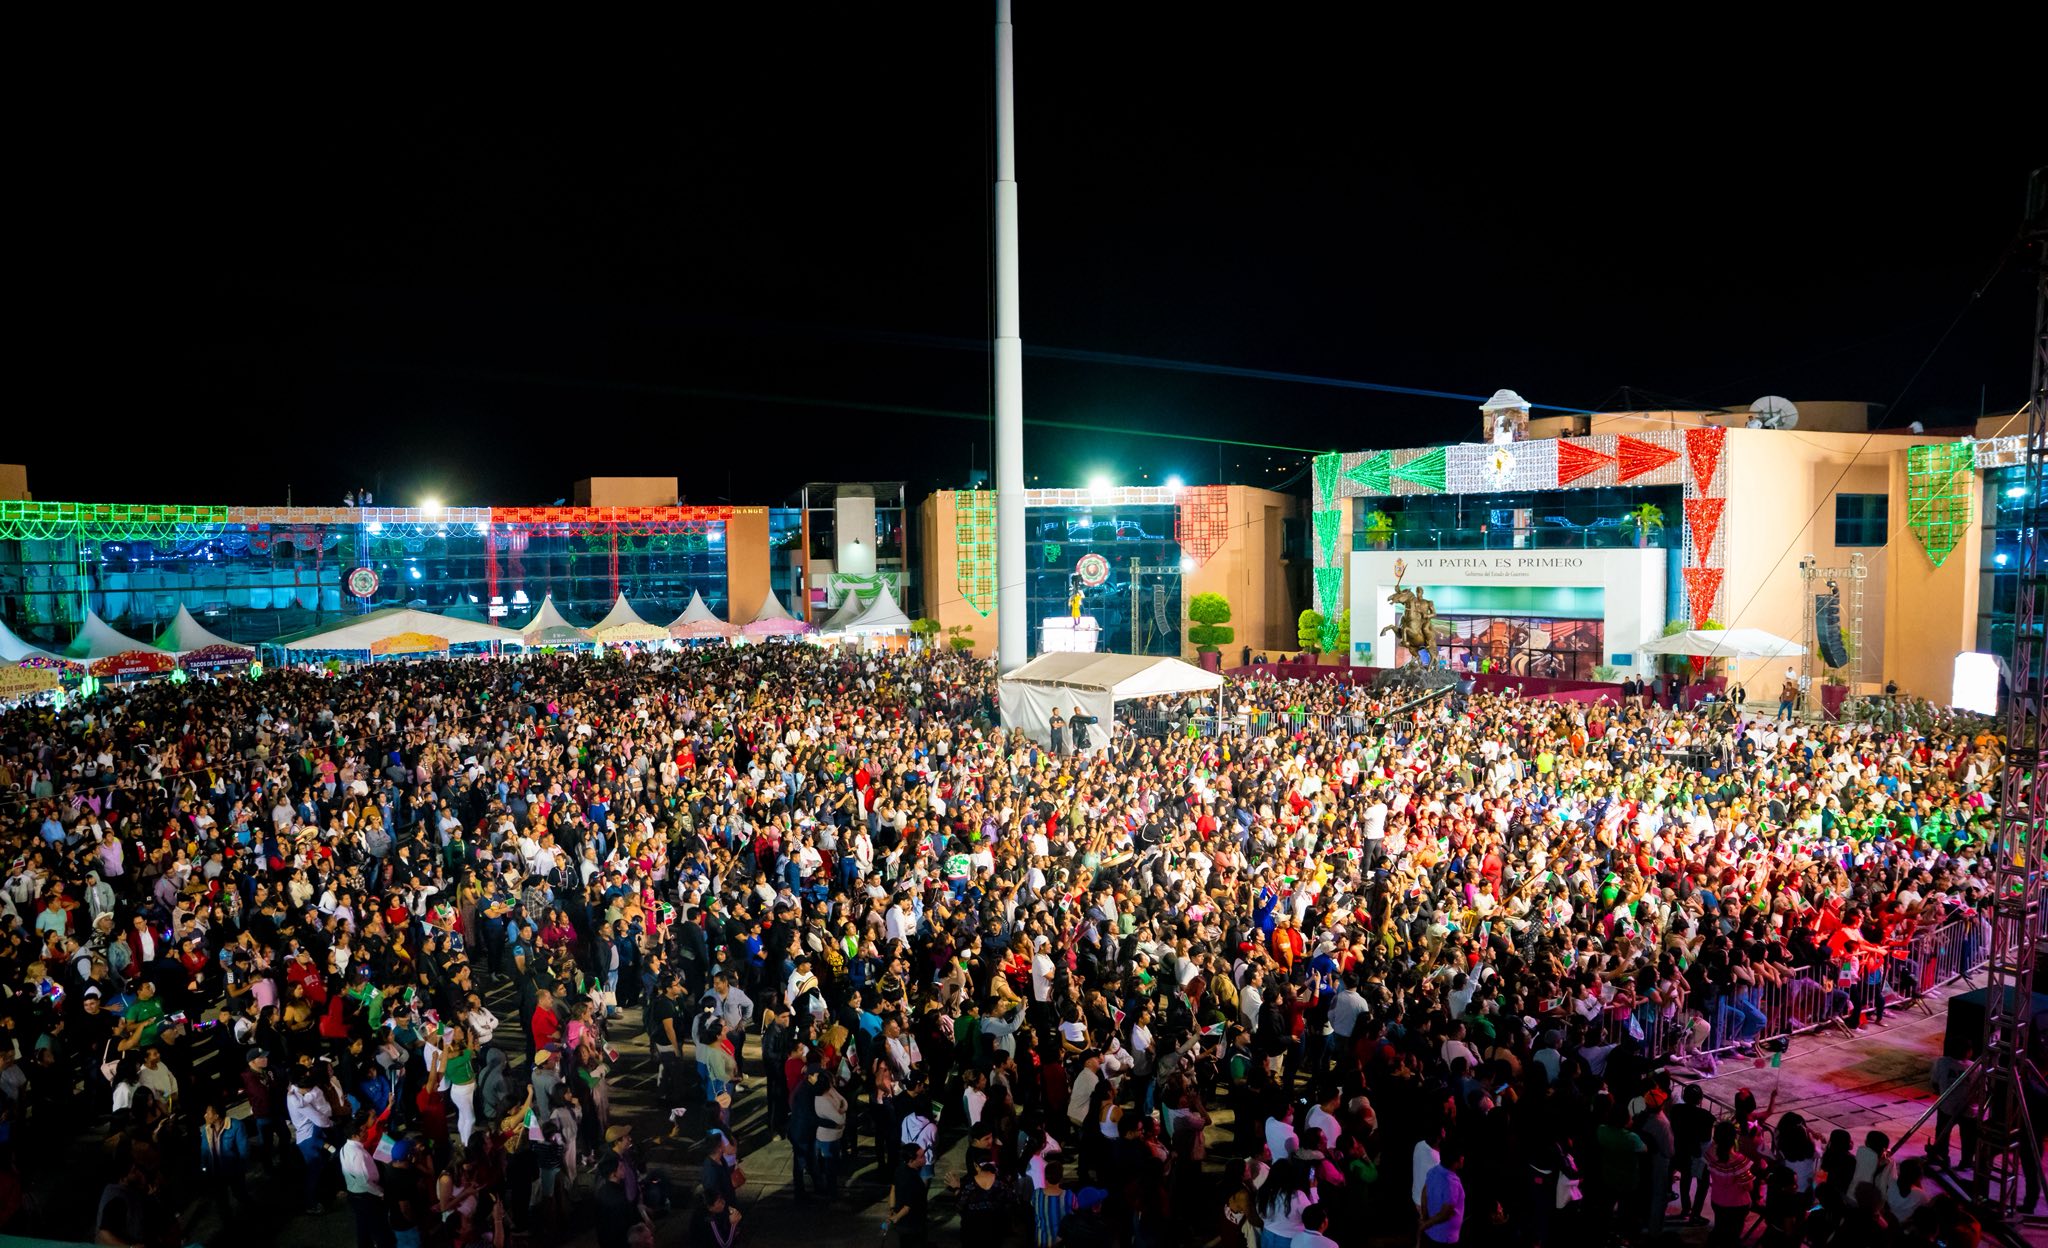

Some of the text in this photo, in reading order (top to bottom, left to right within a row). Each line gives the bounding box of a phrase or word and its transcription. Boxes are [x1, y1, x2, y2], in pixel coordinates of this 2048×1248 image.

[1417, 558, 1583, 568] MI PATRIA ES PRIMERO
[118, 666, 149, 674] ENCHILADAS
